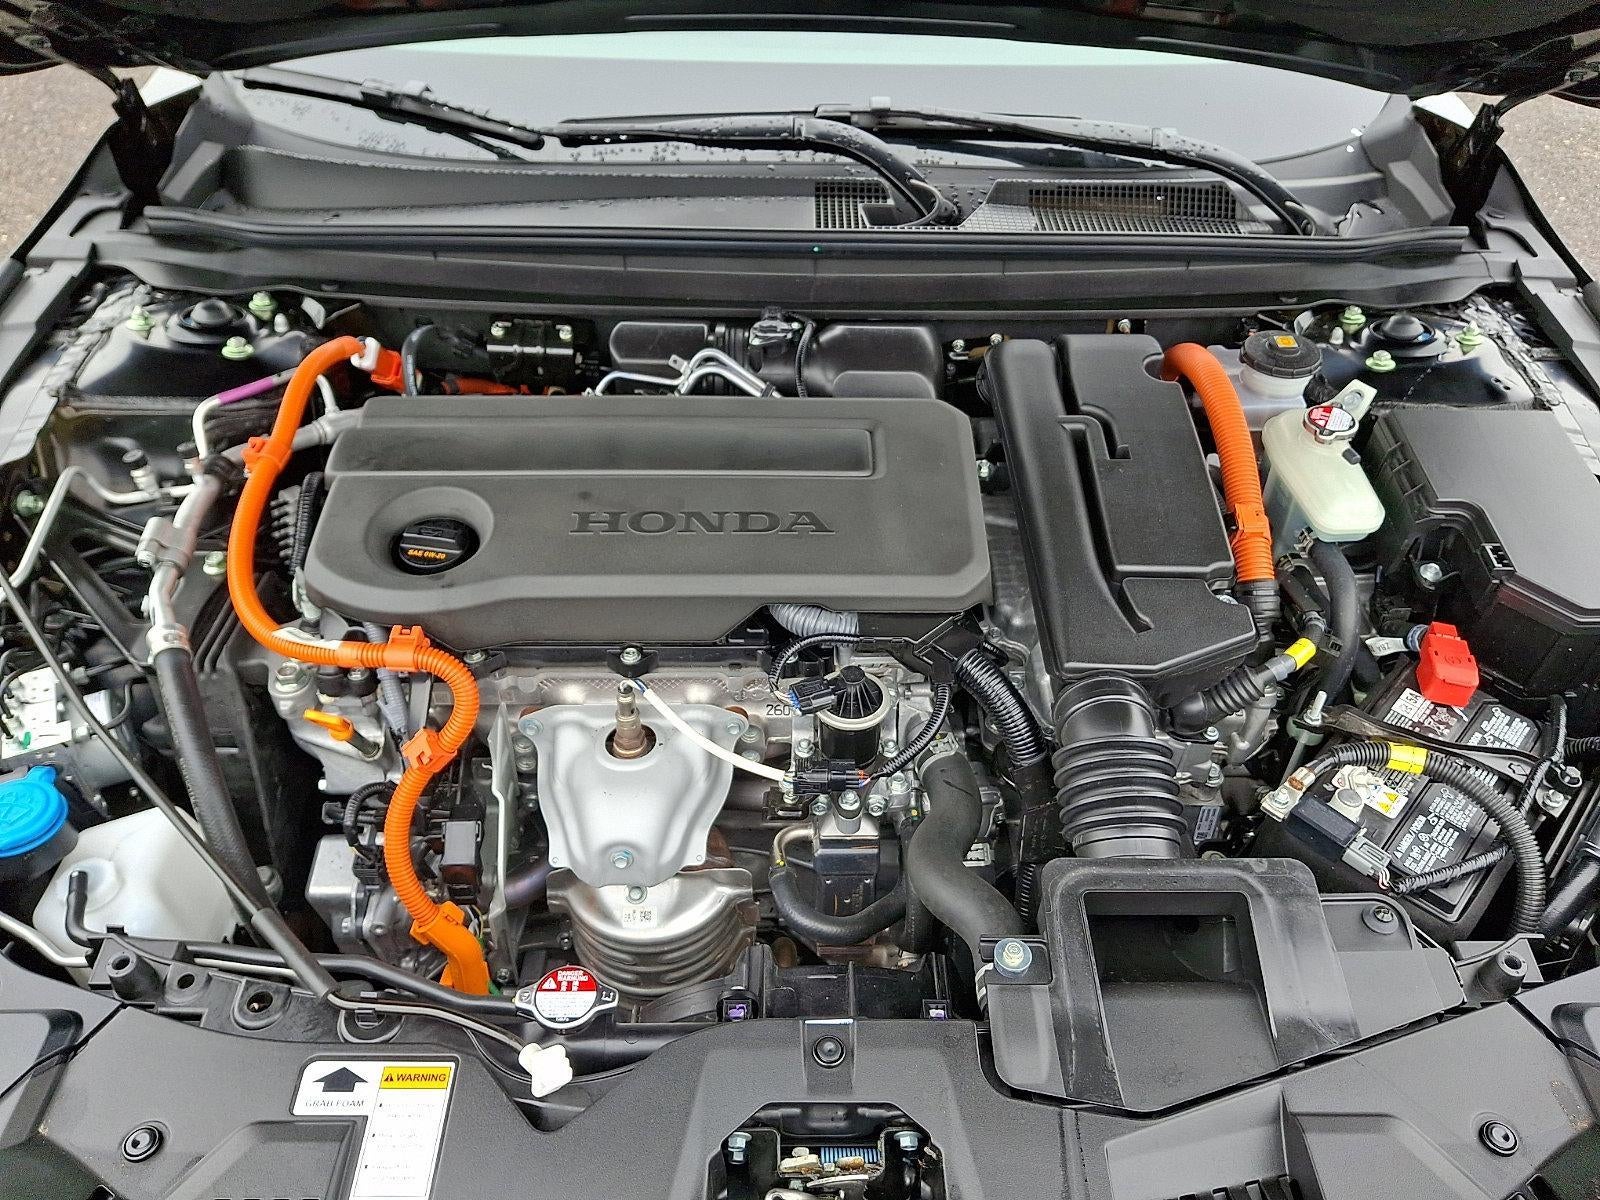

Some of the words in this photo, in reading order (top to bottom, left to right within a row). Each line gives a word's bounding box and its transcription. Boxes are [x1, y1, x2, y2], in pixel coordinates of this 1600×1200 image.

[569, 511, 836, 535] HONDA
[407, 548, 423, 559] SAE
[424, 550, 446, 560] 0W-20
[396, 1073, 447, 1082] WARNING
